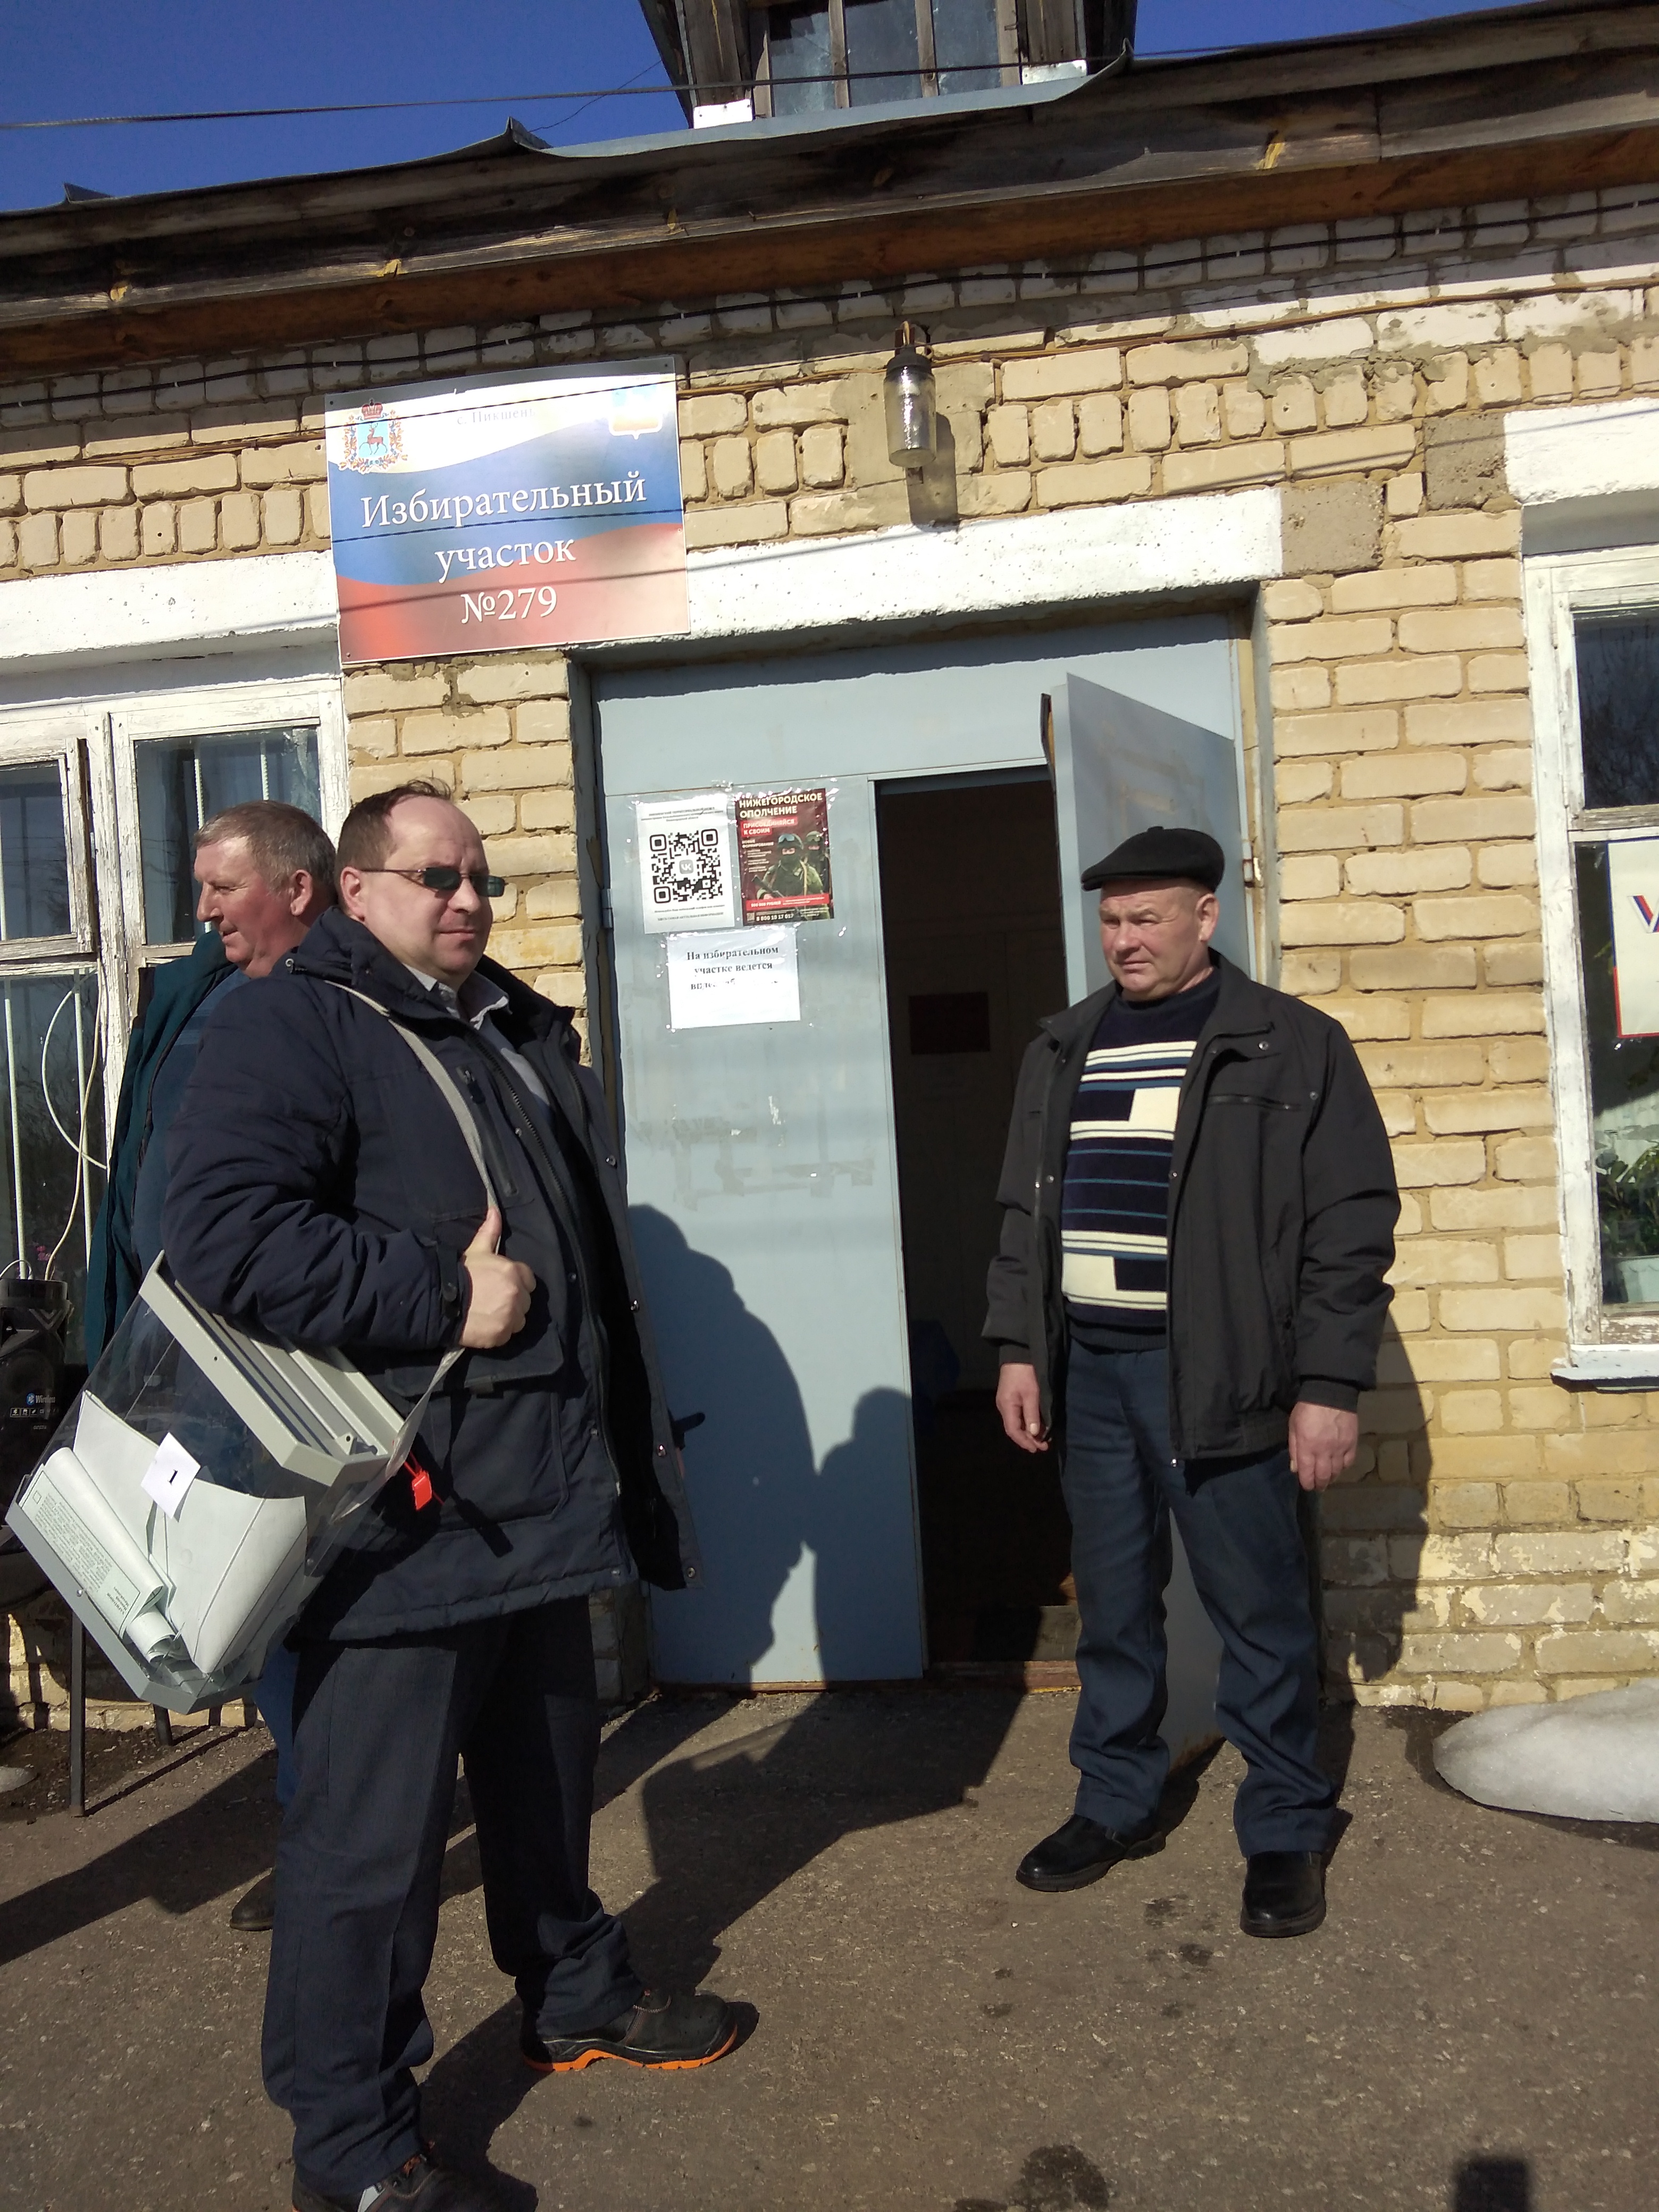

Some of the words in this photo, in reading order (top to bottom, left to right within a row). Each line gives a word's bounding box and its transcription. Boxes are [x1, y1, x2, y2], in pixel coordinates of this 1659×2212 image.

[361, 470, 647, 529] Избирательный
[434, 538, 576, 584] участок
[460, 585, 557, 624] №279
[739, 792, 823, 808] НИЖЕГОРОДСКОЕ
[740, 805, 798, 818] ОПОЛЧЕНИЕ
[743, 819, 794, 828] ПРИСОЕДИНЯЙСЯ
[687, 951, 700, 960] На
[703, 947, 778, 960] избирательном
[694, 966, 733, 977] участке
[736, 962, 773, 972] ведется
[167, 1469, 178, 1486] 1
